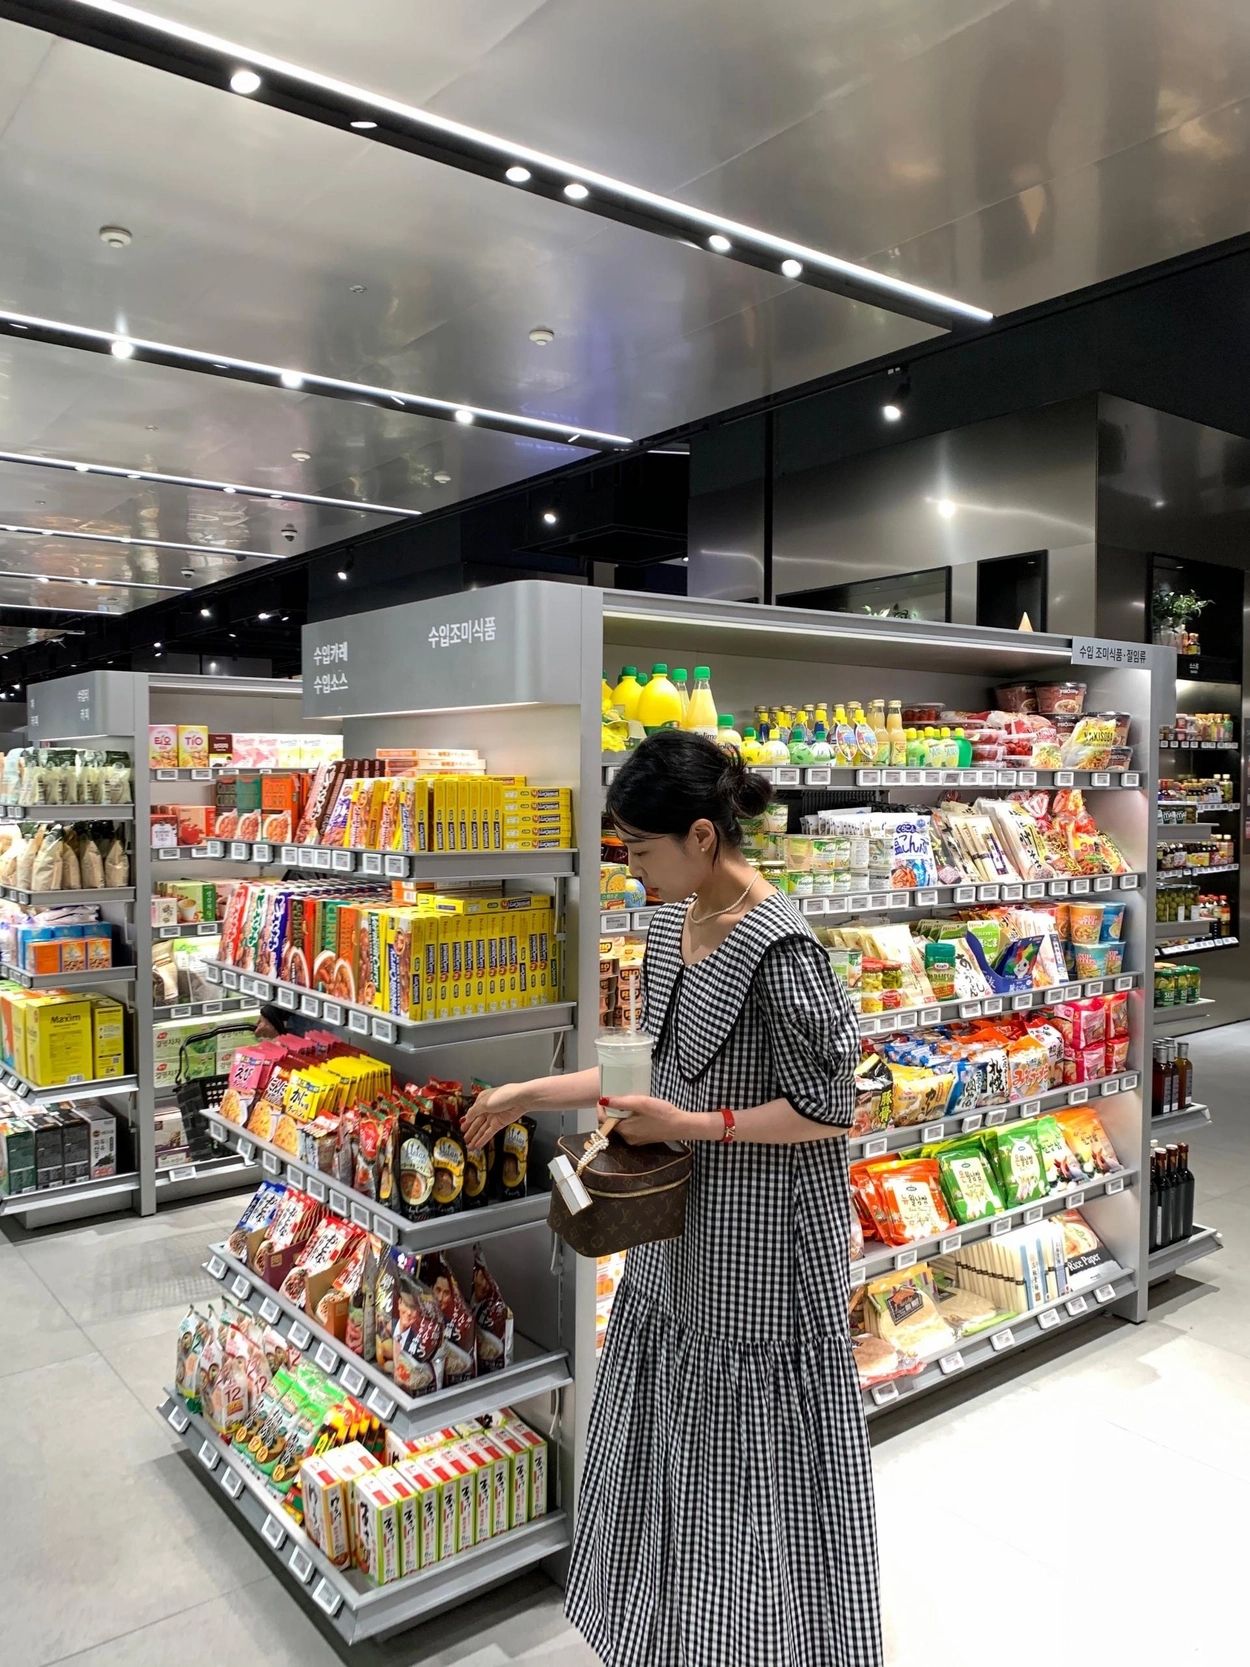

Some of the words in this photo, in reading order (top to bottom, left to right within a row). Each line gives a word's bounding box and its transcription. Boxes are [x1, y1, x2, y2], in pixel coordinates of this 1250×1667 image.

[428, 616, 497, 649] 수입조미식품
[313, 641, 348, 666] 수입카레
[1080, 645, 1094, 659] 수입
[313, 672, 349, 695] 수입소스
[51, 1015, 81, 1023] Maxim
[1067, 1260, 1084, 1271] Rice
[1080, 1253, 1101, 1267] Paper
